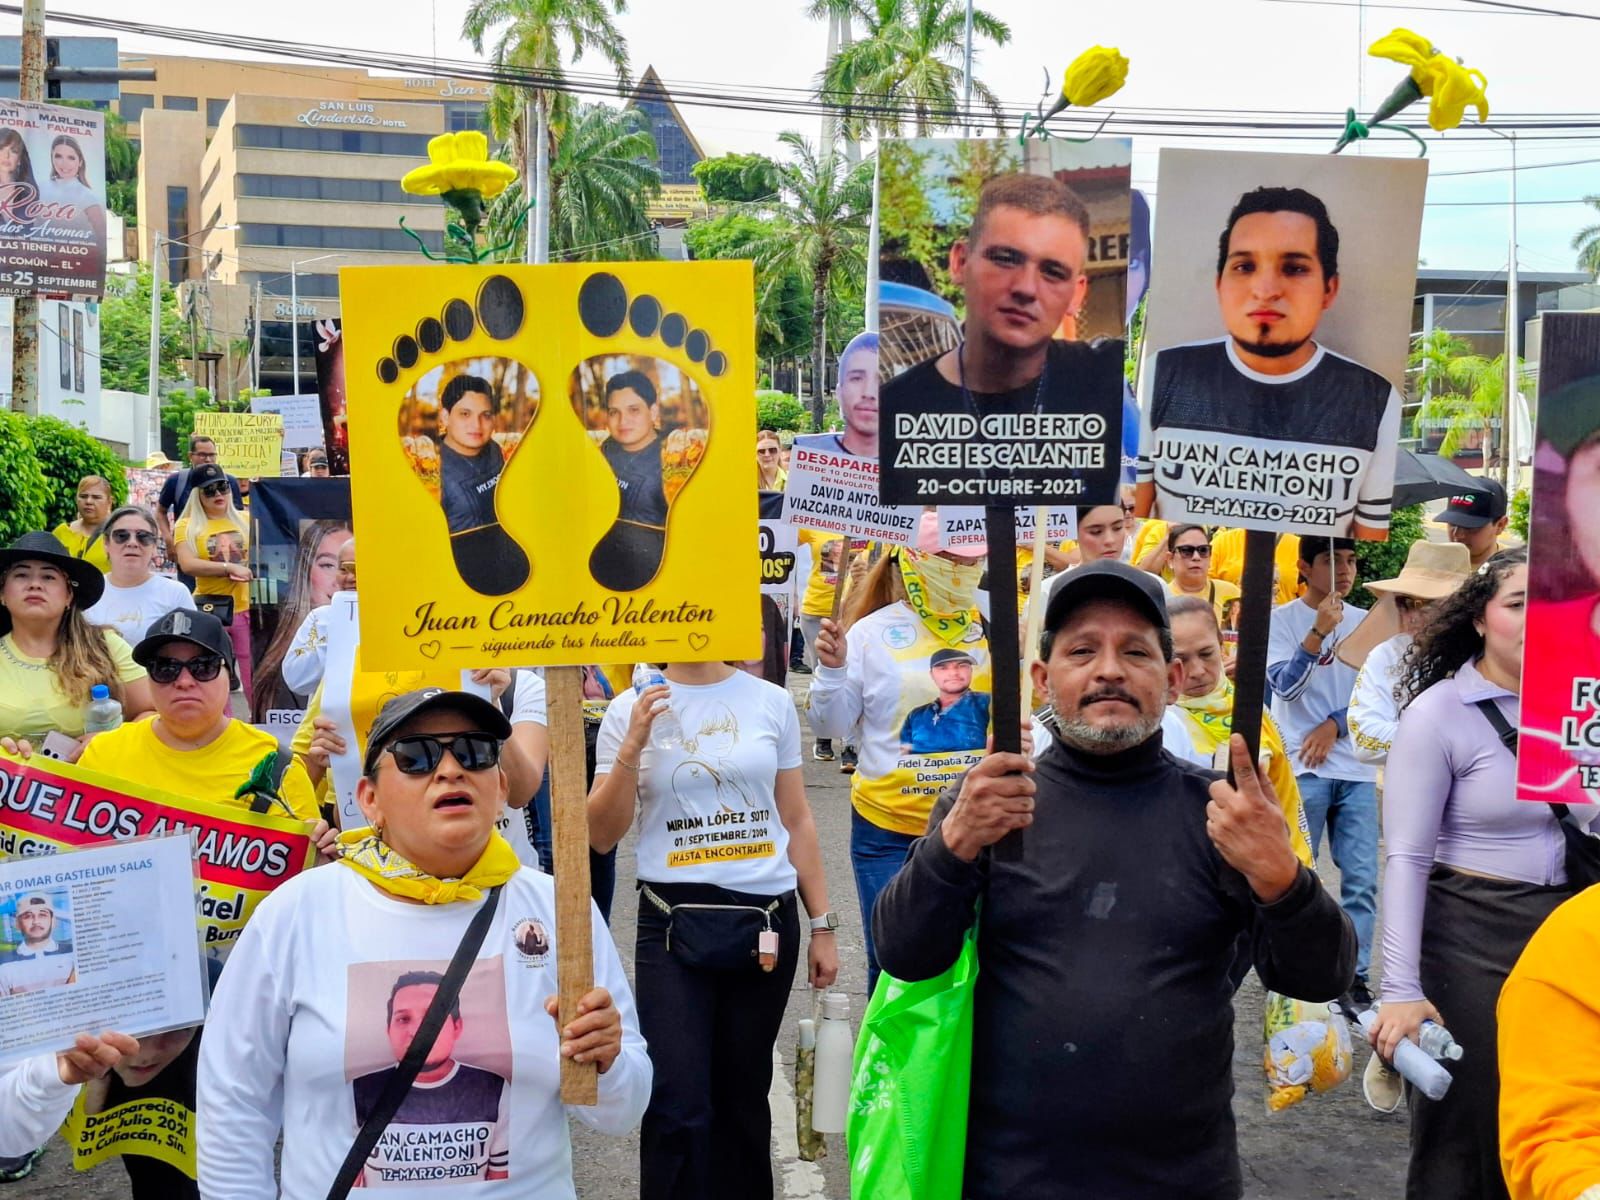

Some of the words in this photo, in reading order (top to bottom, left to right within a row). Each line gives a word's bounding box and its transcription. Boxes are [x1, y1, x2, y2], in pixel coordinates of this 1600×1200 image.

[297, 109, 382, 127] Lindavista
[383, 120, 407, 128] HOTEL
[320, 102, 345, 111] SAN
[349, 103, 374, 112] LUIS
[39, 113, 98, 129] MARLENE
[47, 124, 93, 137] FAVELA
[26, 221, 92, 240] Aromas
[20, 242, 56, 252] TIENEN
[59, 245, 89, 256] ALGO
[13, 271, 34, 286] 25
[38, 275, 97, 289] SEPTIEMBRE
[895, 413, 978, 440] DAVID
[981, 413, 1107, 440] GILBERTO
[893, 443, 962, 469] ARCE
[965, 443, 1105, 469] ESCALANTE
[1153, 440, 1219, 465] JUAN
[1228, 446, 1361, 476] CAMACHO
[796, 463, 826, 474] DESDE
[811, 484, 844, 501] DAVID
[917, 478, 1083, 495] 20-OCTUBRE-2021
[790, 497, 853, 519] VIAZCARRA
[857, 509, 915, 530] URQUIDEZ
[1186, 496, 1337, 525] 12-MARZO-2021
[789, 514, 847, 532] ¡ESPERAMOS
[850, 524, 862, 534] TU
[864, 527, 910, 543] REGRESO!
[404, 601, 480, 638] Juan
[488, 600, 602, 631] Camacho
[602, 596, 717, 628] Valenton
[480, 634, 556, 659] siguiendo
[562, 634, 585, 649] tus
[590, 630, 647, 649] huellas
[897, 759, 921, 769] Fidel
[924, 757, 962, 769] Zapata
[64, 793, 144, 840] LOS
[667, 816, 703, 832] MIRIAM
[708, 810, 745, 826] LÓPEZ
[750, 809, 769, 822] SOTO
[670, 850, 702, 866] ¡HASTA
[705, 843, 773, 859] ENCONTRARTE!
[15, 876, 52, 890] OMAR
[55, 865, 117, 883] GASTELUM
[120, 858, 153, 873] SALAS
[86, 1100, 175, 1128] Desapareció
[178, 1110, 188, 1122] el
[80, 1131, 95, 1143] 31
[98, 1124, 115, 1138] de
[157, 1116, 188, 1139] 2021
[406, 1127, 489, 1146] CAMACHO
[96, 1129, 162, 1152] Culiacán,
[166, 1135, 186, 1155] Sin.
[382, 1163, 479, 1181] 12-MARZO-2021
